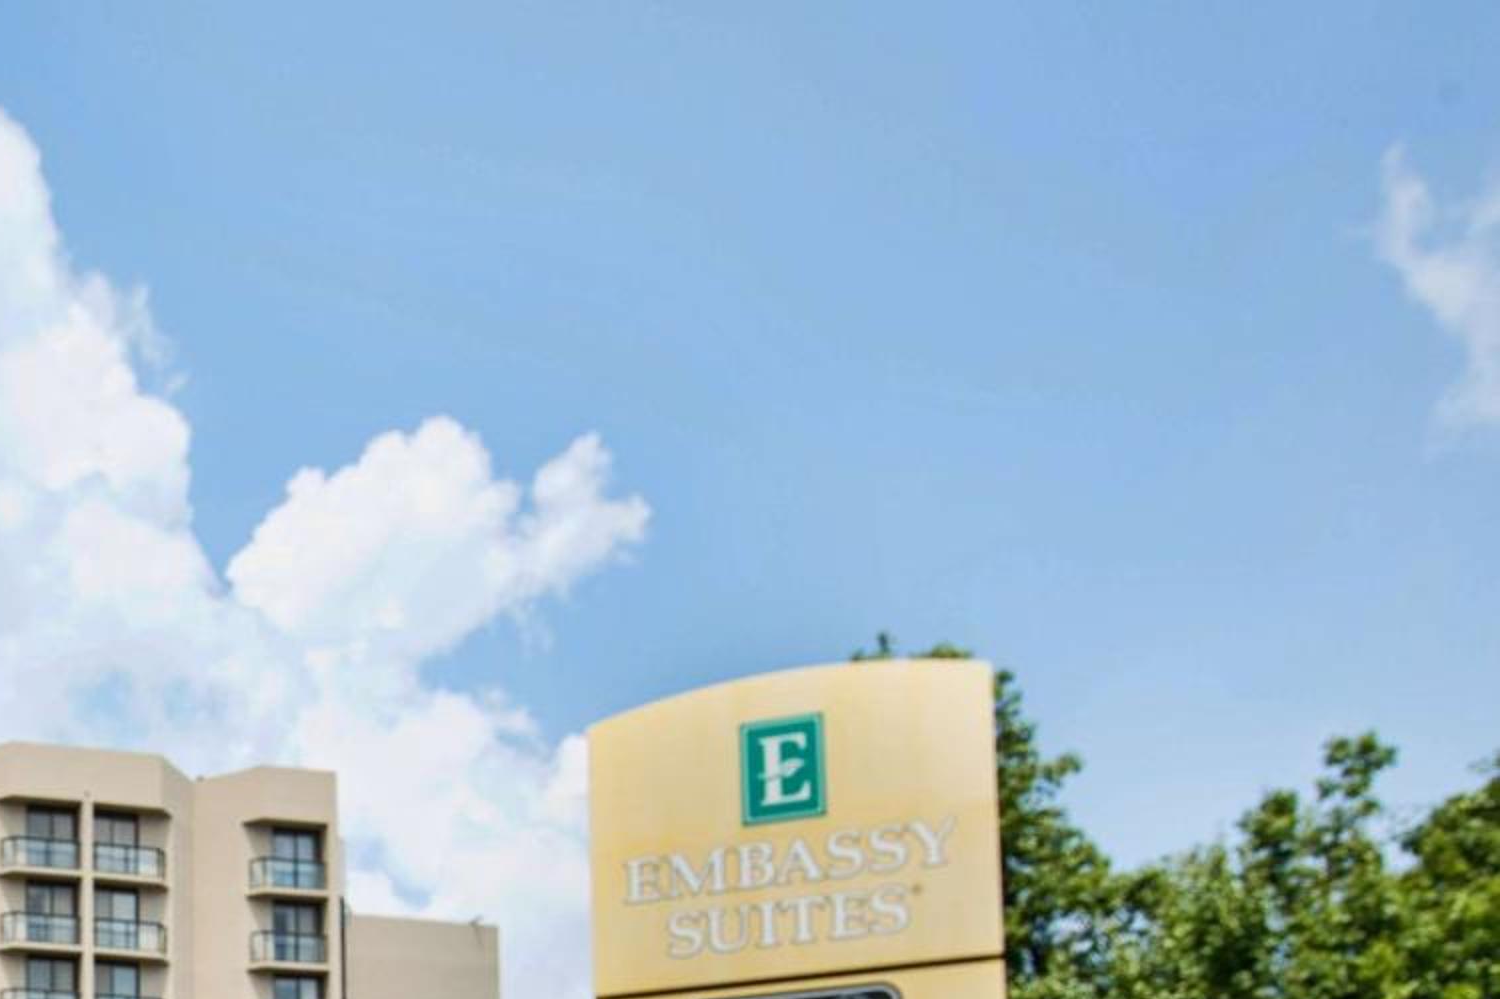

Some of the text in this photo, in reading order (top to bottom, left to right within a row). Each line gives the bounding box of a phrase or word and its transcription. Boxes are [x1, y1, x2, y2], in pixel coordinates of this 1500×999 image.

[757, 731, 812, 807] E
[624, 815, 956, 905] EMBASSY
[668, 883, 911, 959] SUITES
